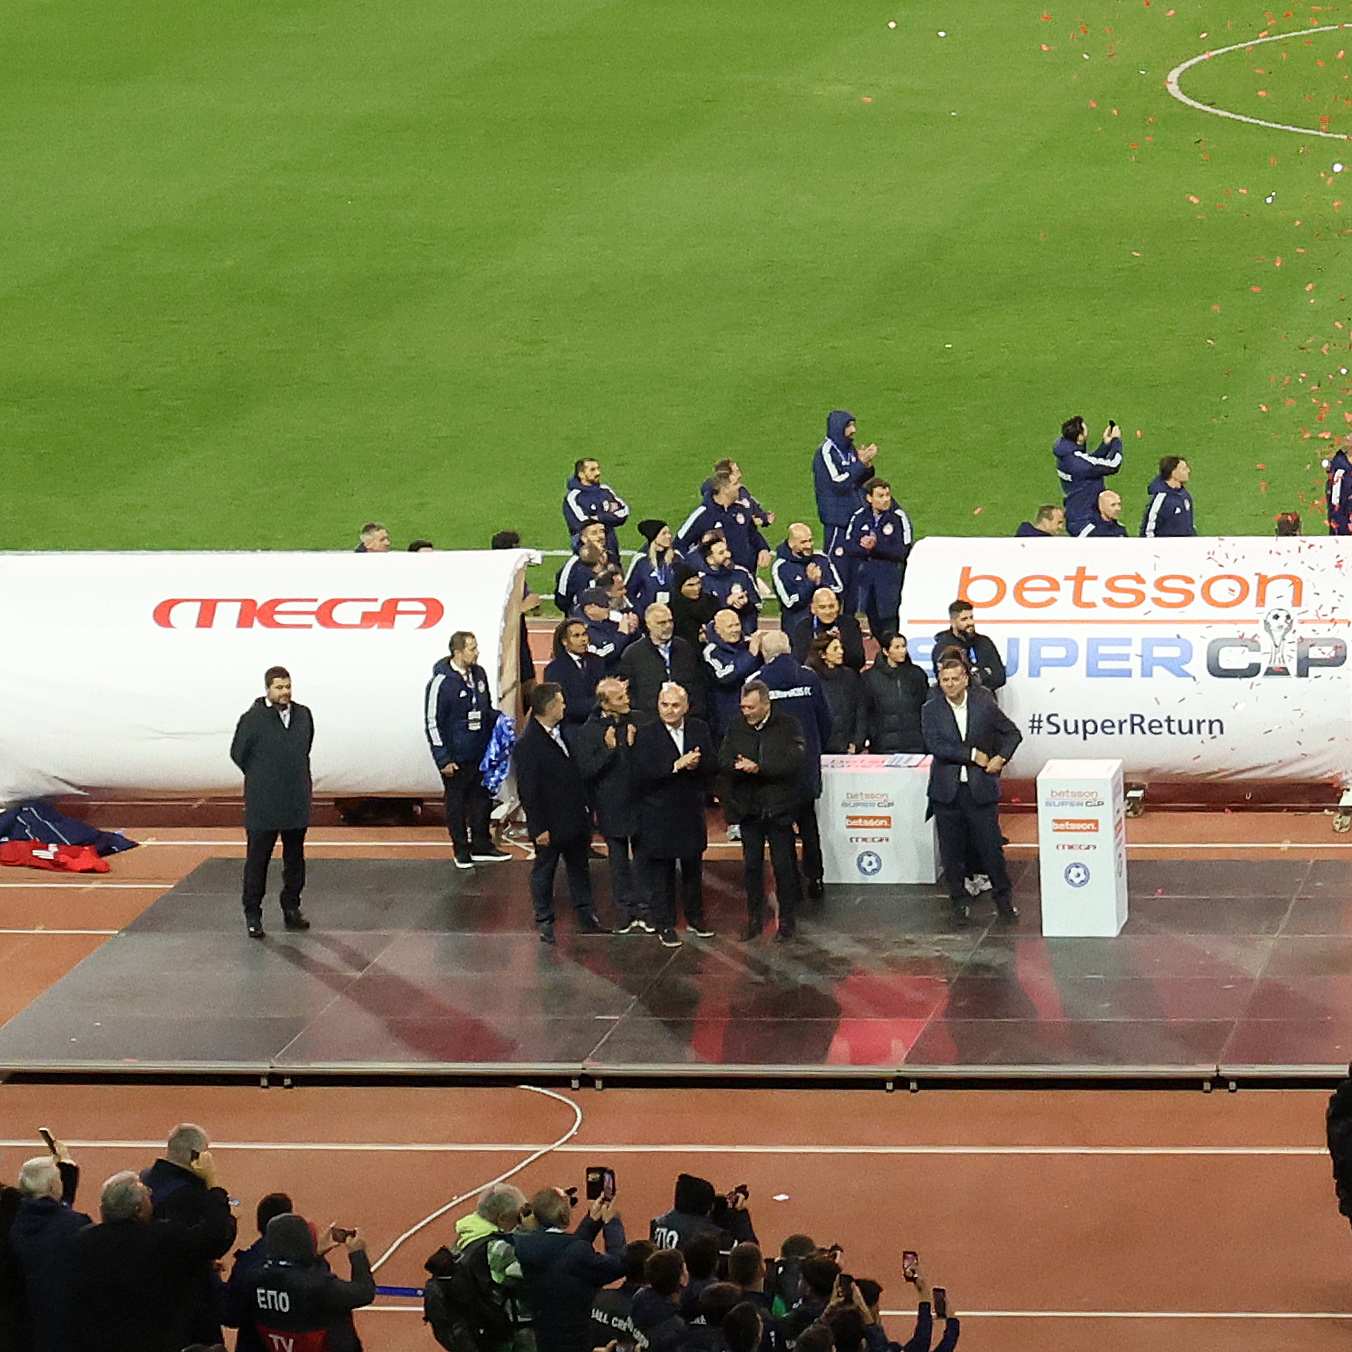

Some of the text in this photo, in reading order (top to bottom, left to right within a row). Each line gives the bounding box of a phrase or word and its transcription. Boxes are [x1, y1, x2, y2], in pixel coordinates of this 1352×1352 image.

[957, 566, 1304, 609] betsson
[153, 597, 444, 629] MEGA
[1028, 713, 1226, 740] #SuperReturn
[1051, 788, 1098, 798] betsson
[256, 1286, 290, 1313] ΕΠΟ
